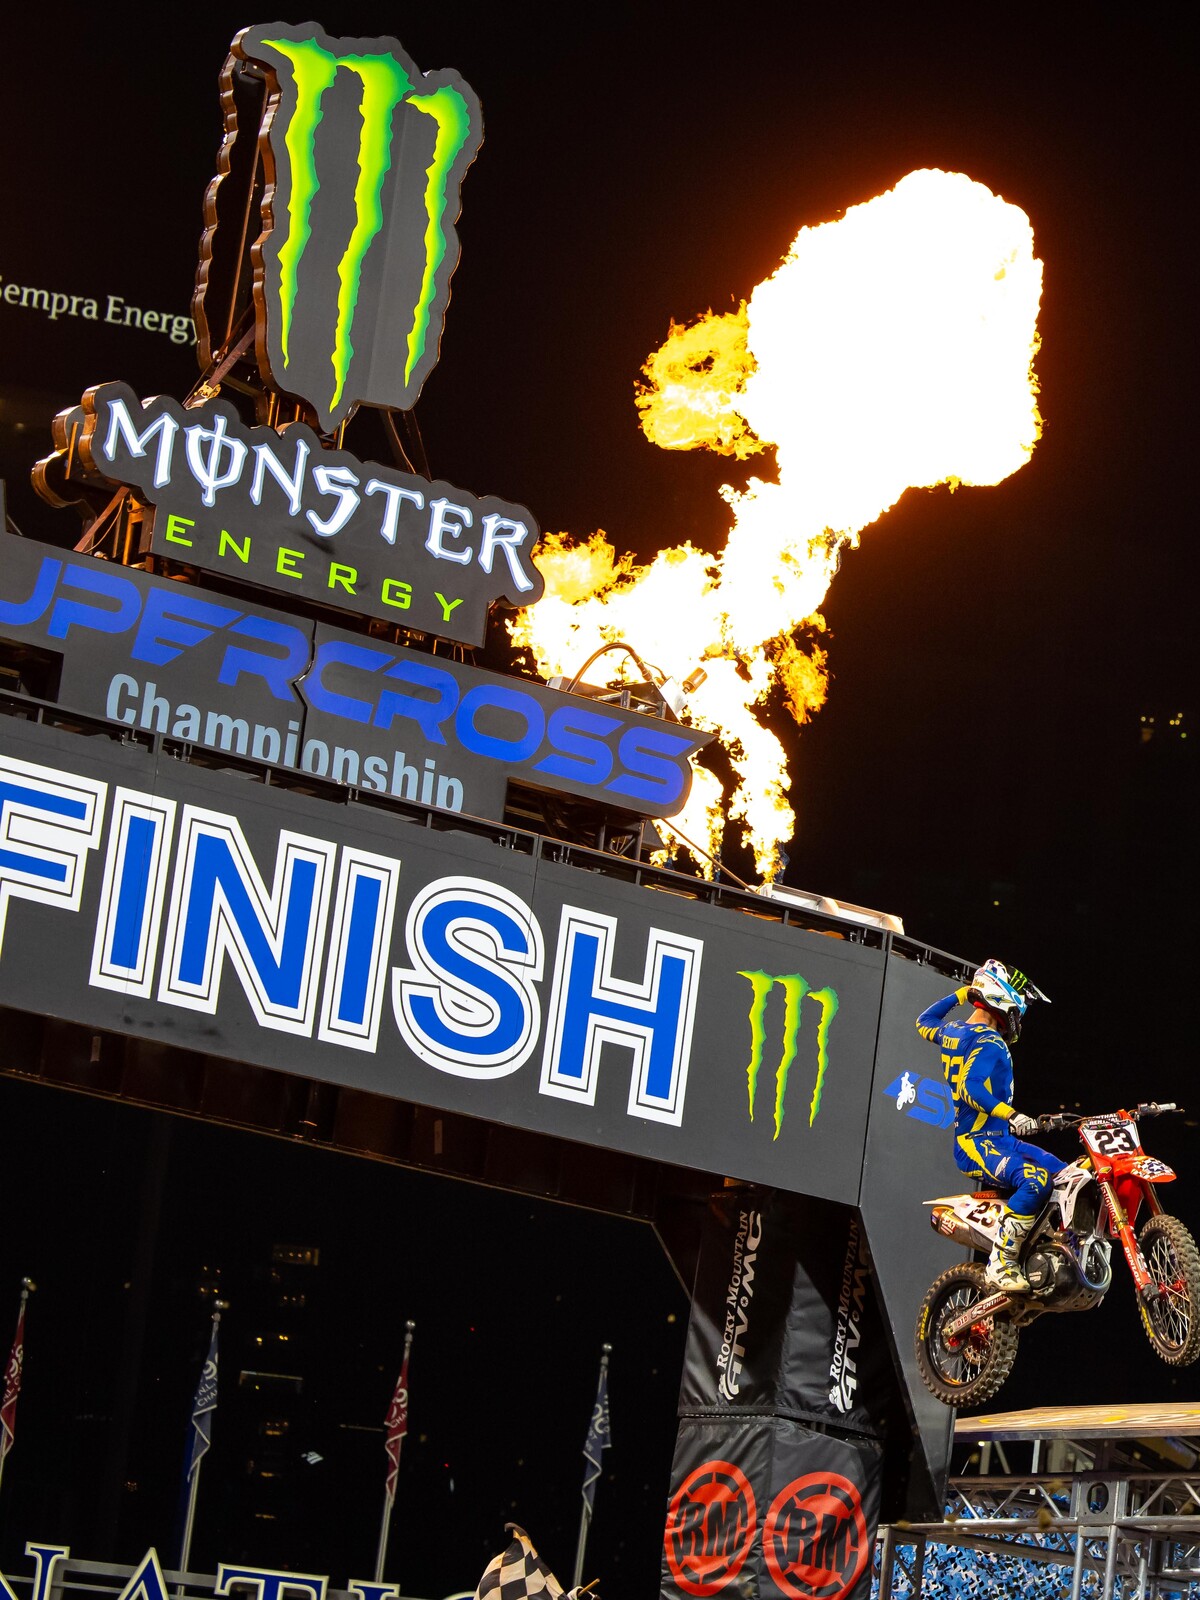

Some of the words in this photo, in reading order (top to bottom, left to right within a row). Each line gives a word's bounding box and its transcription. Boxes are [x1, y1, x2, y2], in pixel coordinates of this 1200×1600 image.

[0, 275, 98, 320] empra
[165, 514, 464, 622] ENERGY
[0, 754, 704, 1128] FINISH
[1023, 1163, 1048, 1188] 23
[1094, 1127, 1137, 1155] 23
[726, 1210, 749, 1308] MOUNTAIN
